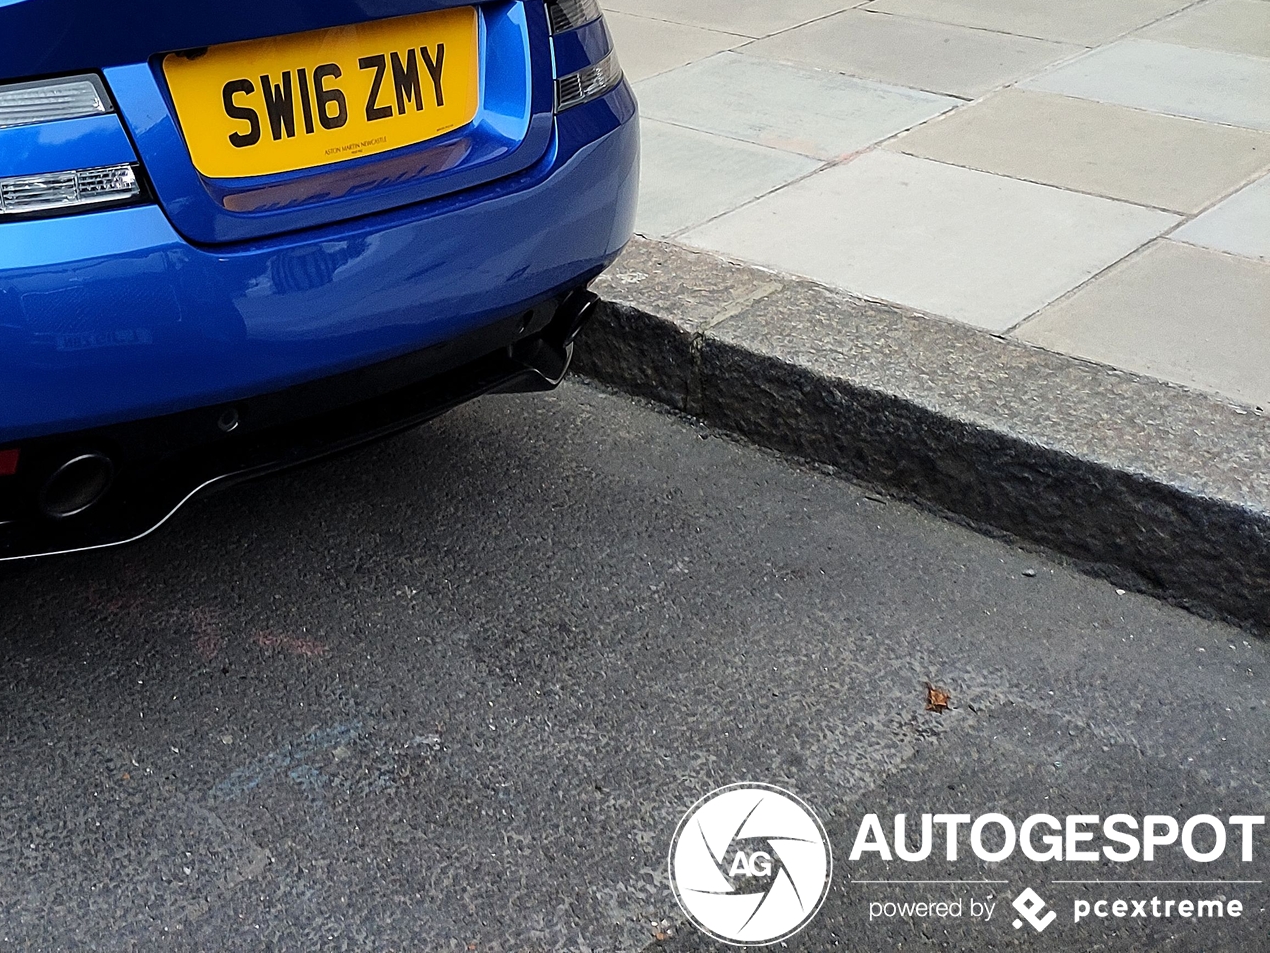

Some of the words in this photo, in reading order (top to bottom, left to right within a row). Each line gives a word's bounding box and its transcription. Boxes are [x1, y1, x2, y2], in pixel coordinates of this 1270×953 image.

[222, 63, 348, 148] SW16
[358, 43, 444, 122] ZMY
[325, 147, 341, 155] ASTON
[342, 143, 360, 151] MARTIN
[361, 136, 387, 147] NEWCASTLE
